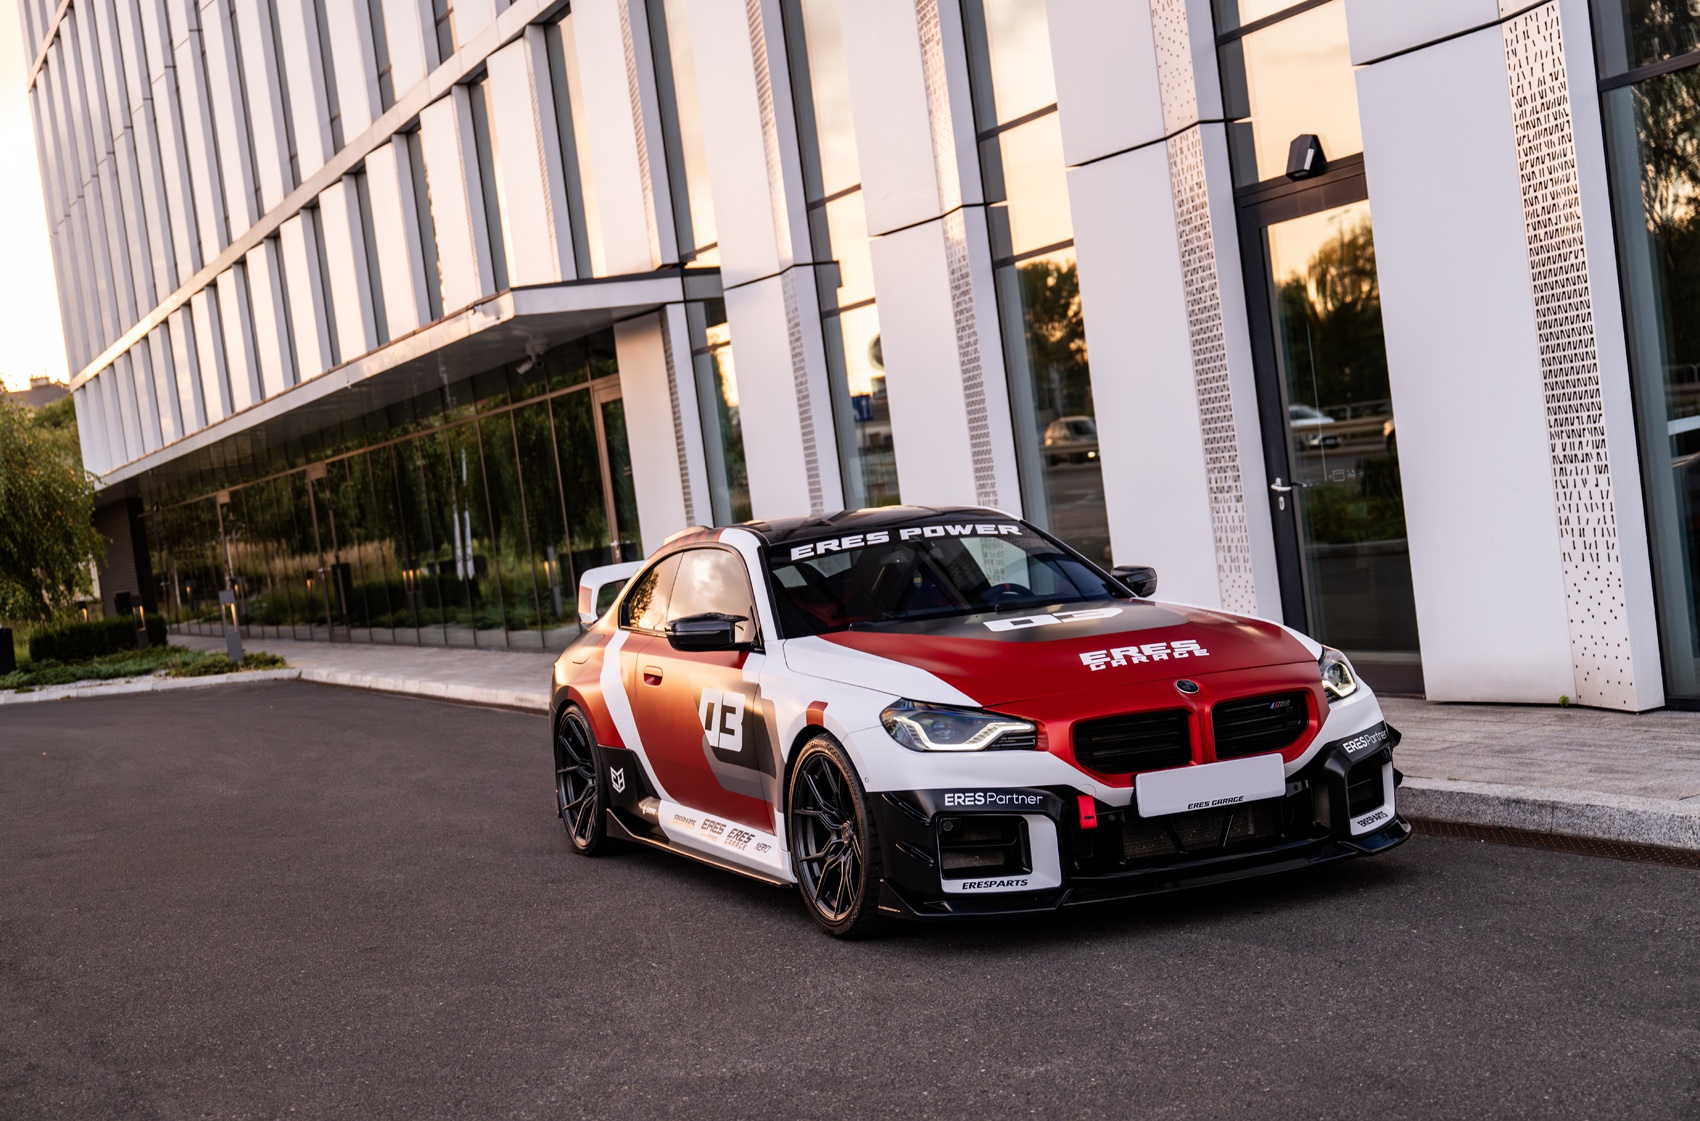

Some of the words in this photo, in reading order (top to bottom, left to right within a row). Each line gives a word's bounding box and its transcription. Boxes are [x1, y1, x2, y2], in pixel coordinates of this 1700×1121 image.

[790, 531, 890, 561] ERES
[899, 524, 1023, 540] POWER
[983, 607, 1124, 632] 03
[1078, 639, 1201, 666] ERES
[1089, 648, 1210, 671] GARAGE
[699, 687, 746, 752] 03
[1187, 801, 1210, 810] ERES
[1211, 796, 1245, 806] GARAGE
[700, 818, 727, 835] ERES
[726, 828, 756, 845] ERES
[723, 838, 748, 851] GARAGE
[961, 879, 1028, 890] ERESPARTS
